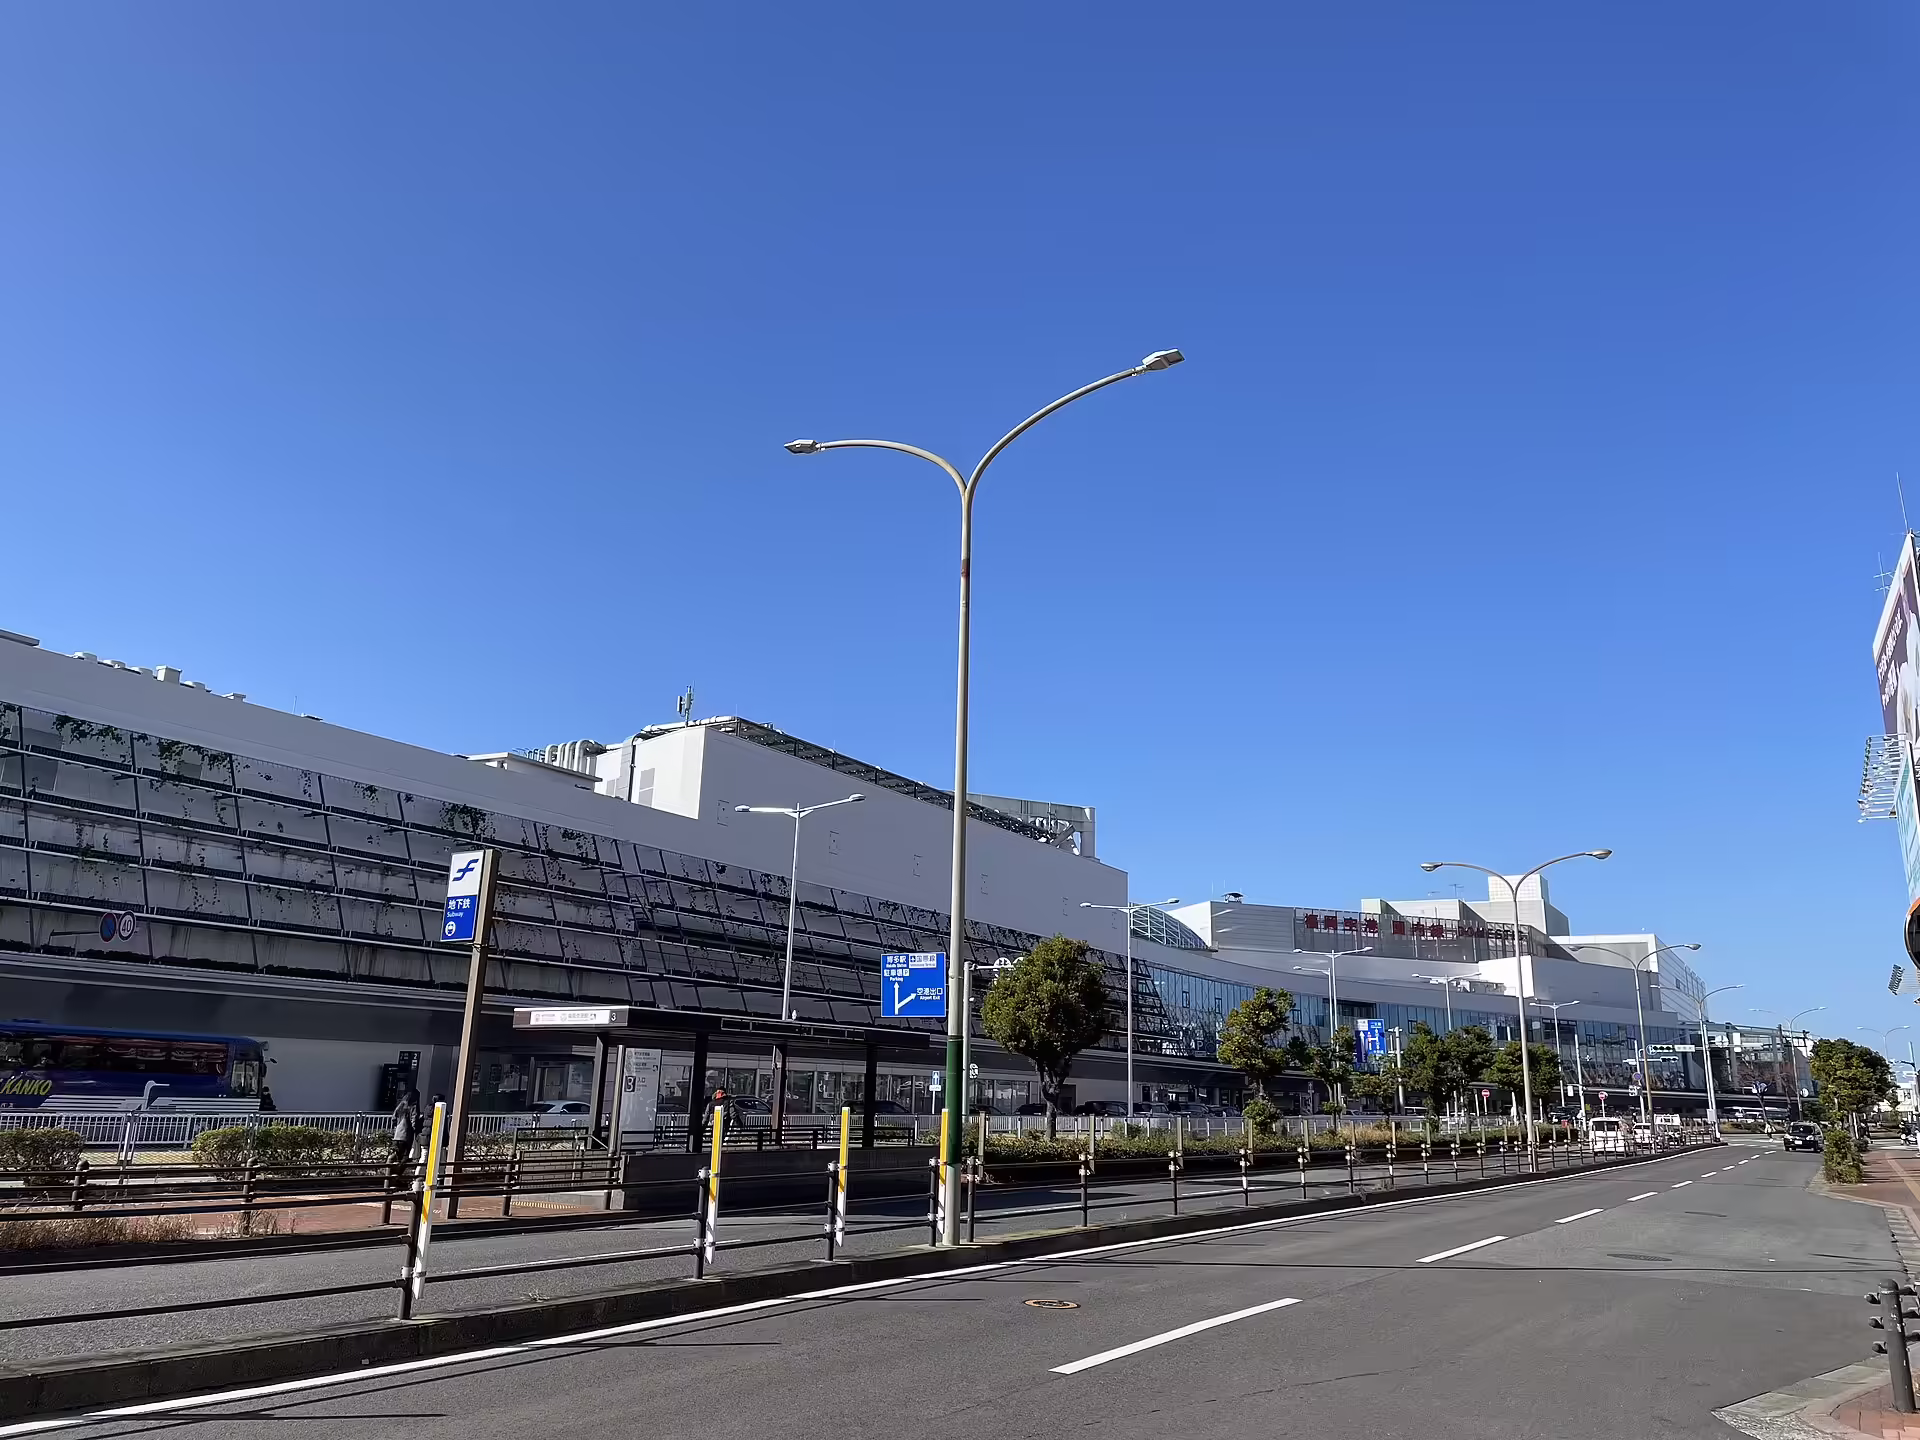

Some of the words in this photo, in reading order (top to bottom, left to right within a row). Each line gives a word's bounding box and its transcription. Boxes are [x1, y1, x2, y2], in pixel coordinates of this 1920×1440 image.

[447, 898, 471, 910] 地下鉄
[122, 919, 132, 933] 40
[611, 1012, 617, 1021] 3
[1, 1078, 52, 1095] KANKO
[626, 1076, 634, 1092] 3
